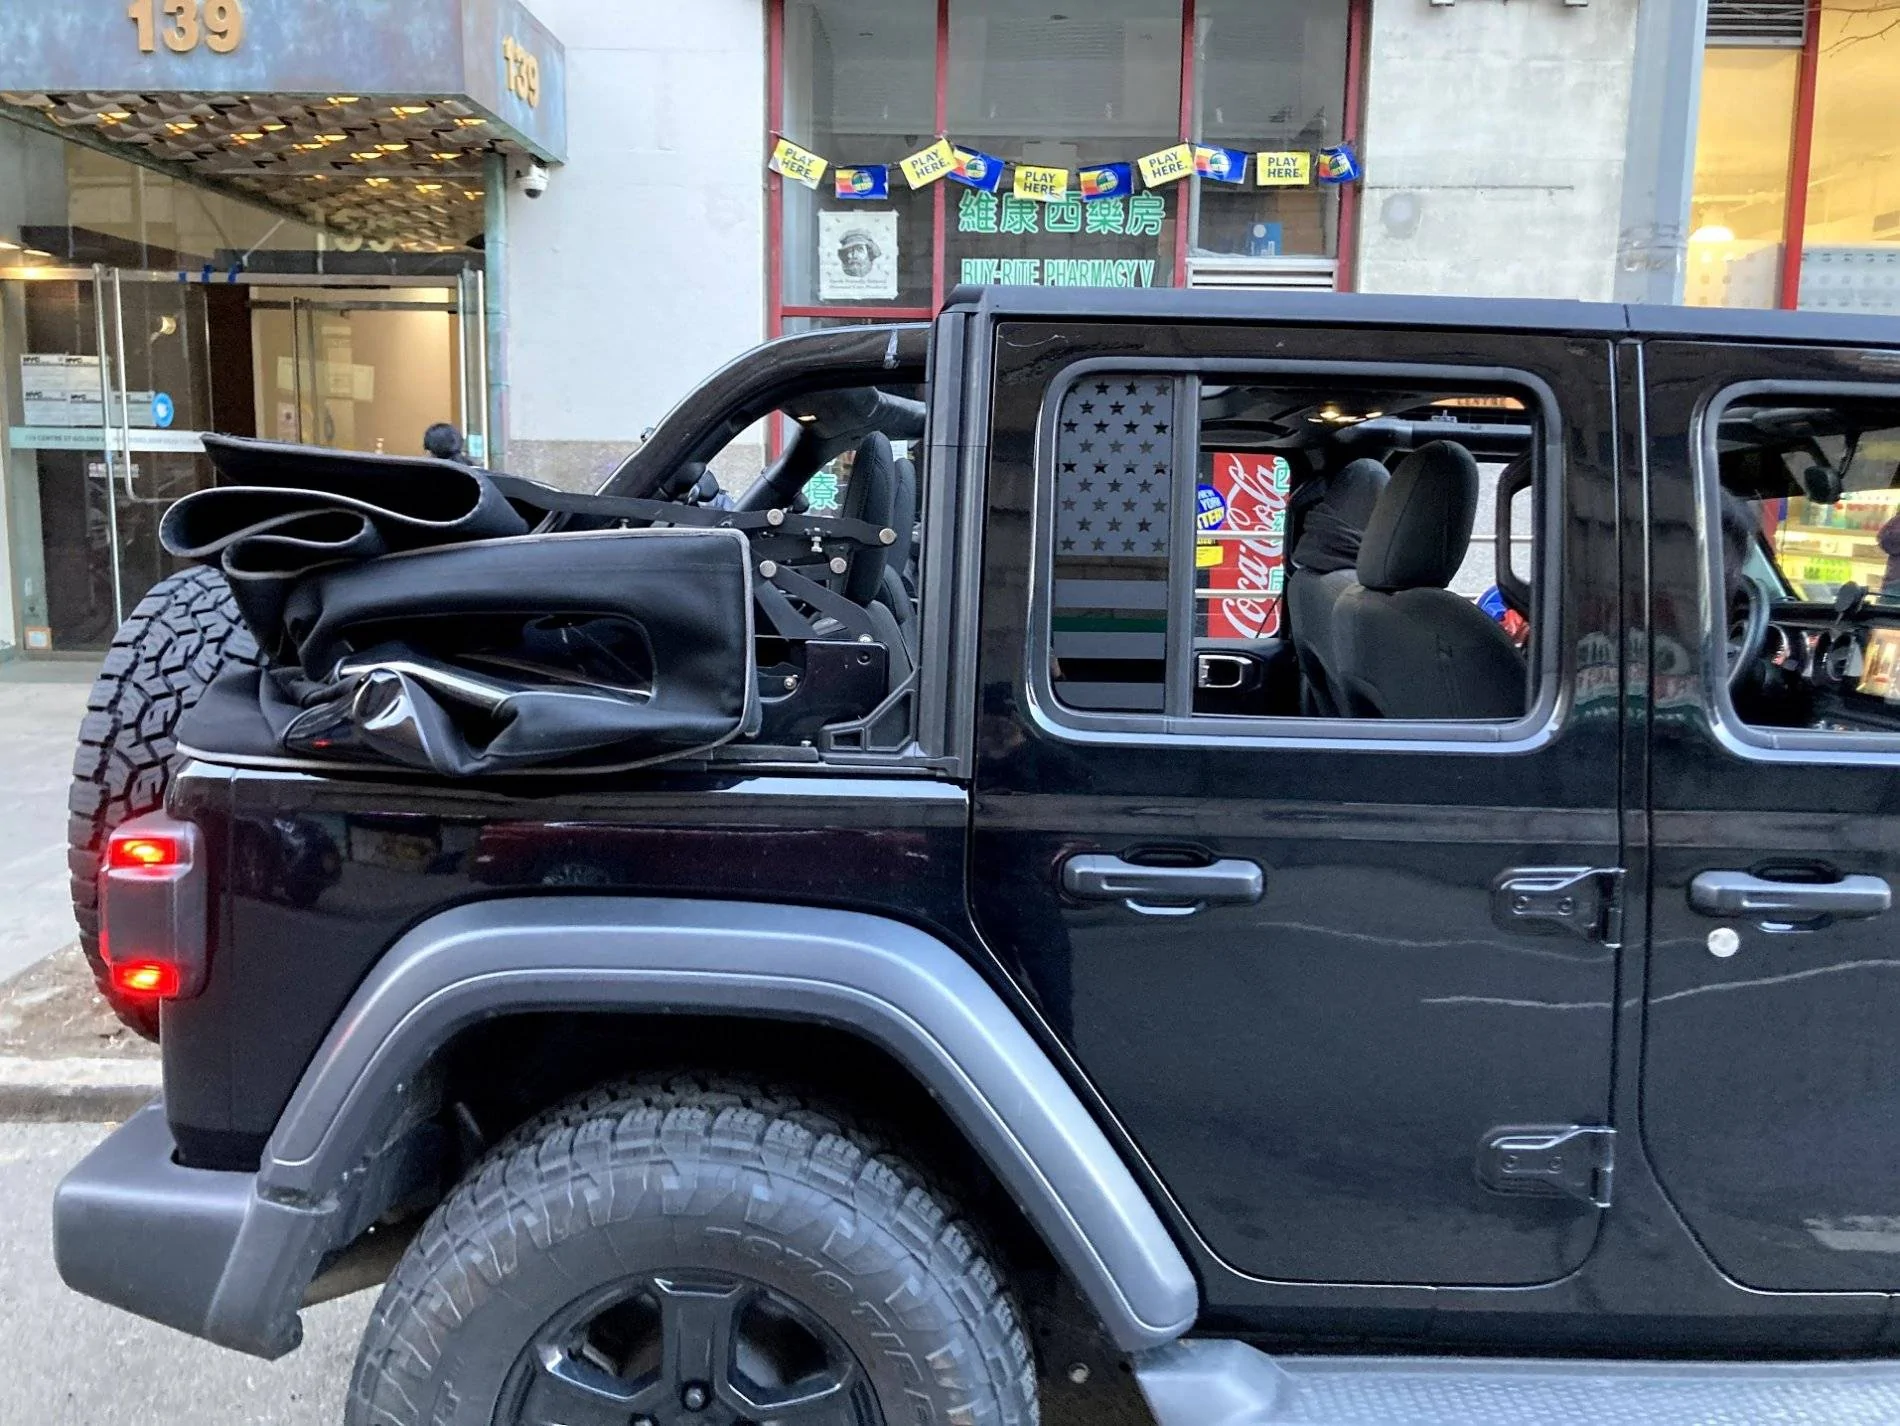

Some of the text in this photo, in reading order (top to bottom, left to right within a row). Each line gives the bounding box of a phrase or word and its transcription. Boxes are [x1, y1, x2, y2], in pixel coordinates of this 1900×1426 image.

[128, 0, 244, 52] 139
[504, 35, 542, 109] 139
[784, 147, 815, 166] PLAY
[911, 148, 940, 169] PLAY
[1148, 151, 1179, 168] PLAY
[1267, 156, 1298, 167] PLAY
[1024, 171, 1056, 183] PLAY
[961, 259, 1155, 287] BUY-RITE PHARMACY V
